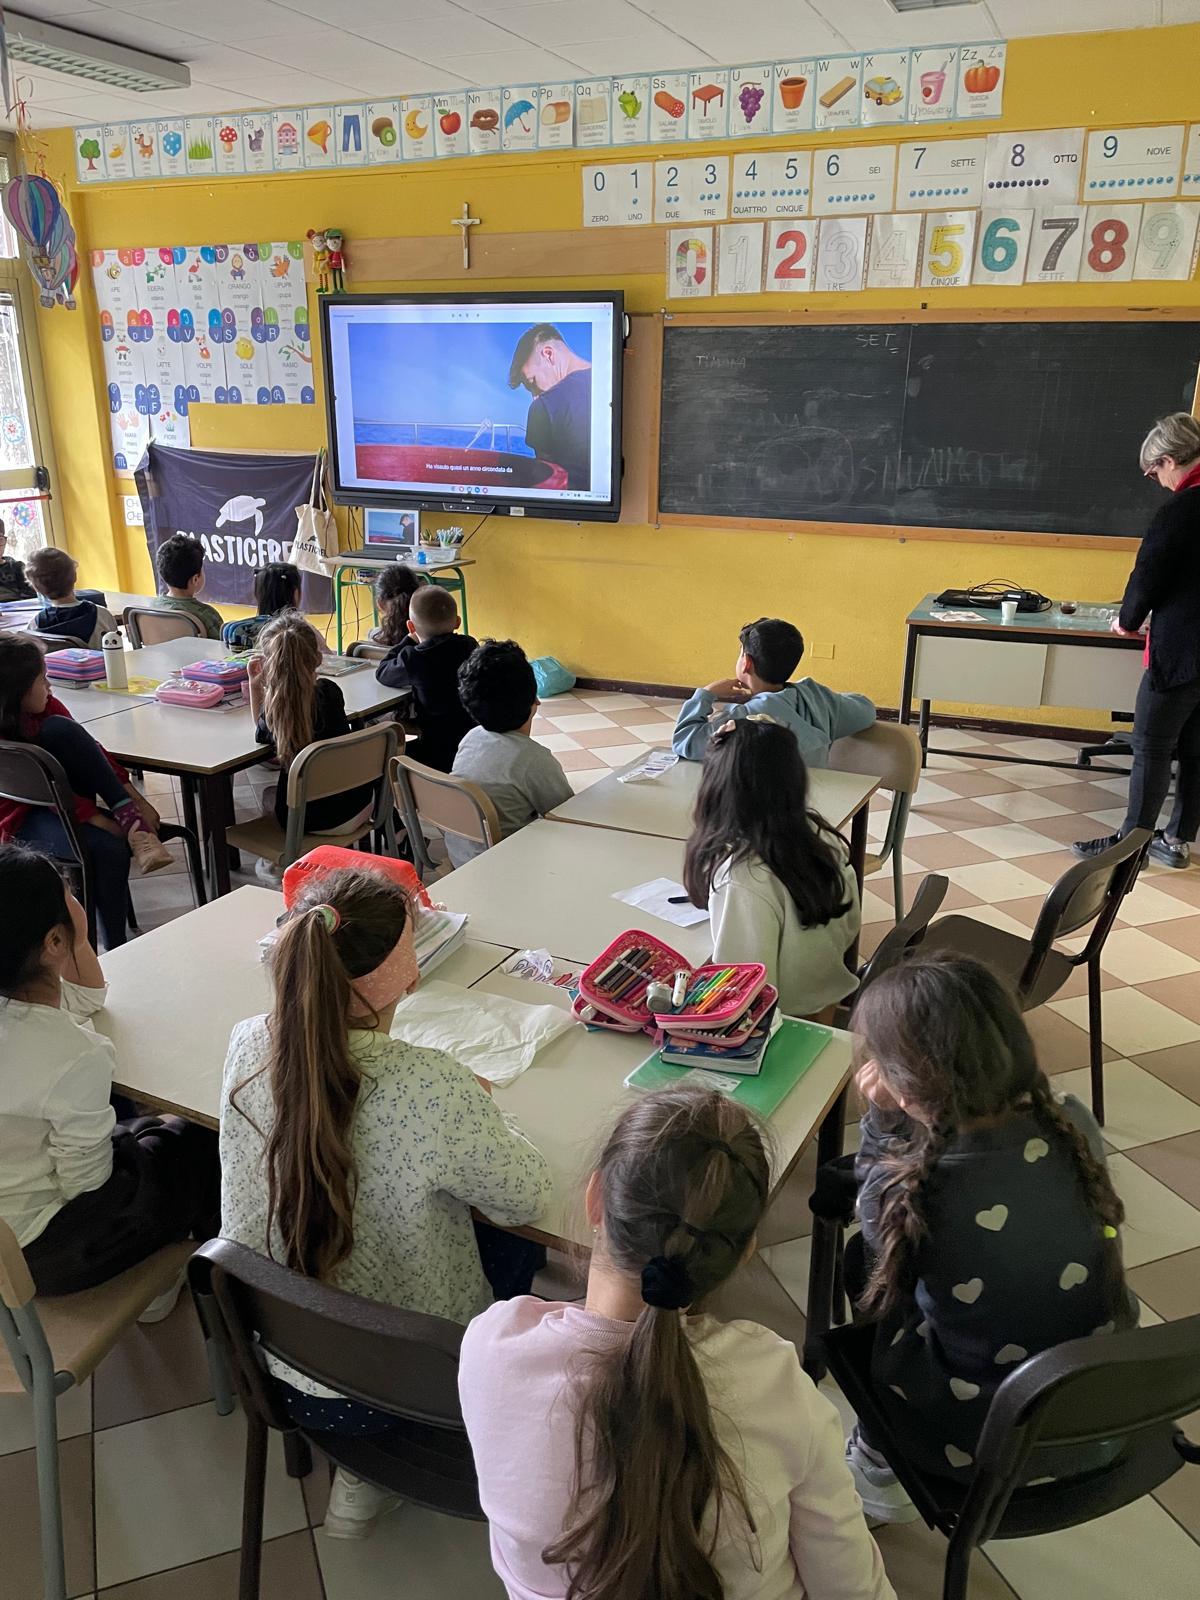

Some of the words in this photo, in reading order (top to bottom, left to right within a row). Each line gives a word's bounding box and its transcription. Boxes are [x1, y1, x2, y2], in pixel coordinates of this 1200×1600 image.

[915, 53, 922, 63] Y
[949, 52, 956, 63] y
[962, 49, 978, 61] Zz
[818, 61, 830, 72] W
[850, 61, 860, 69] w
[866, 56, 874, 68] X
[900, 56, 906, 64] x
[732, 71, 740, 81] U
[764, 70, 770, 78] u
[776, 67, 789, 78] Vv
[613, 82, 624, 92] Rr
[653, 78, 666, 88] Ss
[504, 90, 511, 100] O
[541, 88, 552, 100] Pp
[577, 86, 591, 96] Qq
[434, 98, 448, 108] Mm
[469, 95, 480, 104] Nn
[368, 106, 374, 115] K
[243, 118, 254, 128] Gg
[1103, 136, 1118, 158] 9
[1147, 147, 1171, 156] NOVE
[913, 147, 927, 169] 7
[951, 158, 976, 168] SETTE
[1011, 144, 1025, 166] 8
[1053, 154, 1077, 163] OTTO
[745, 160, 757, 180] 4
[785, 158, 798, 179] 5
[826, 154, 840, 176] 6
[868, 166, 880, 174] SEI
[594, 172, 605, 191] 0
[630, 169, 638, 189] 1
[667, 167, 678, 186] 2
[705, 164, 716, 184] 3
[734, 206, 767, 214] QUATTRO
[776, 205, 804, 213] CINQUE
[592, 215, 609, 223] ZERO
[628, 213, 643, 221] UNO
[981, 217, 1020, 272] 6
[1042, 218, 1079, 271] 7
[1088, 219, 1129, 273] 8
[1143, 212, 1184, 270] 9
[218, 249, 225, 260] O
[774, 230, 807, 279] 2
[928, 224, 965, 277] 5
[135, 252, 142, 263] E
[824, 231, 858, 284] 3
[825, 282, 844, 291] TRE
[930, 277, 960, 286] CINQUE
[224, 312, 232, 324] O
[105, 329, 111, 339] P
[144, 329, 150, 340] L
[184, 329, 191, 340] V
[226, 329, 232, 340] S
[269, 328, 276, 339] R
[112, 402, 119, 410] M
[152, 402, 157, 412] F
